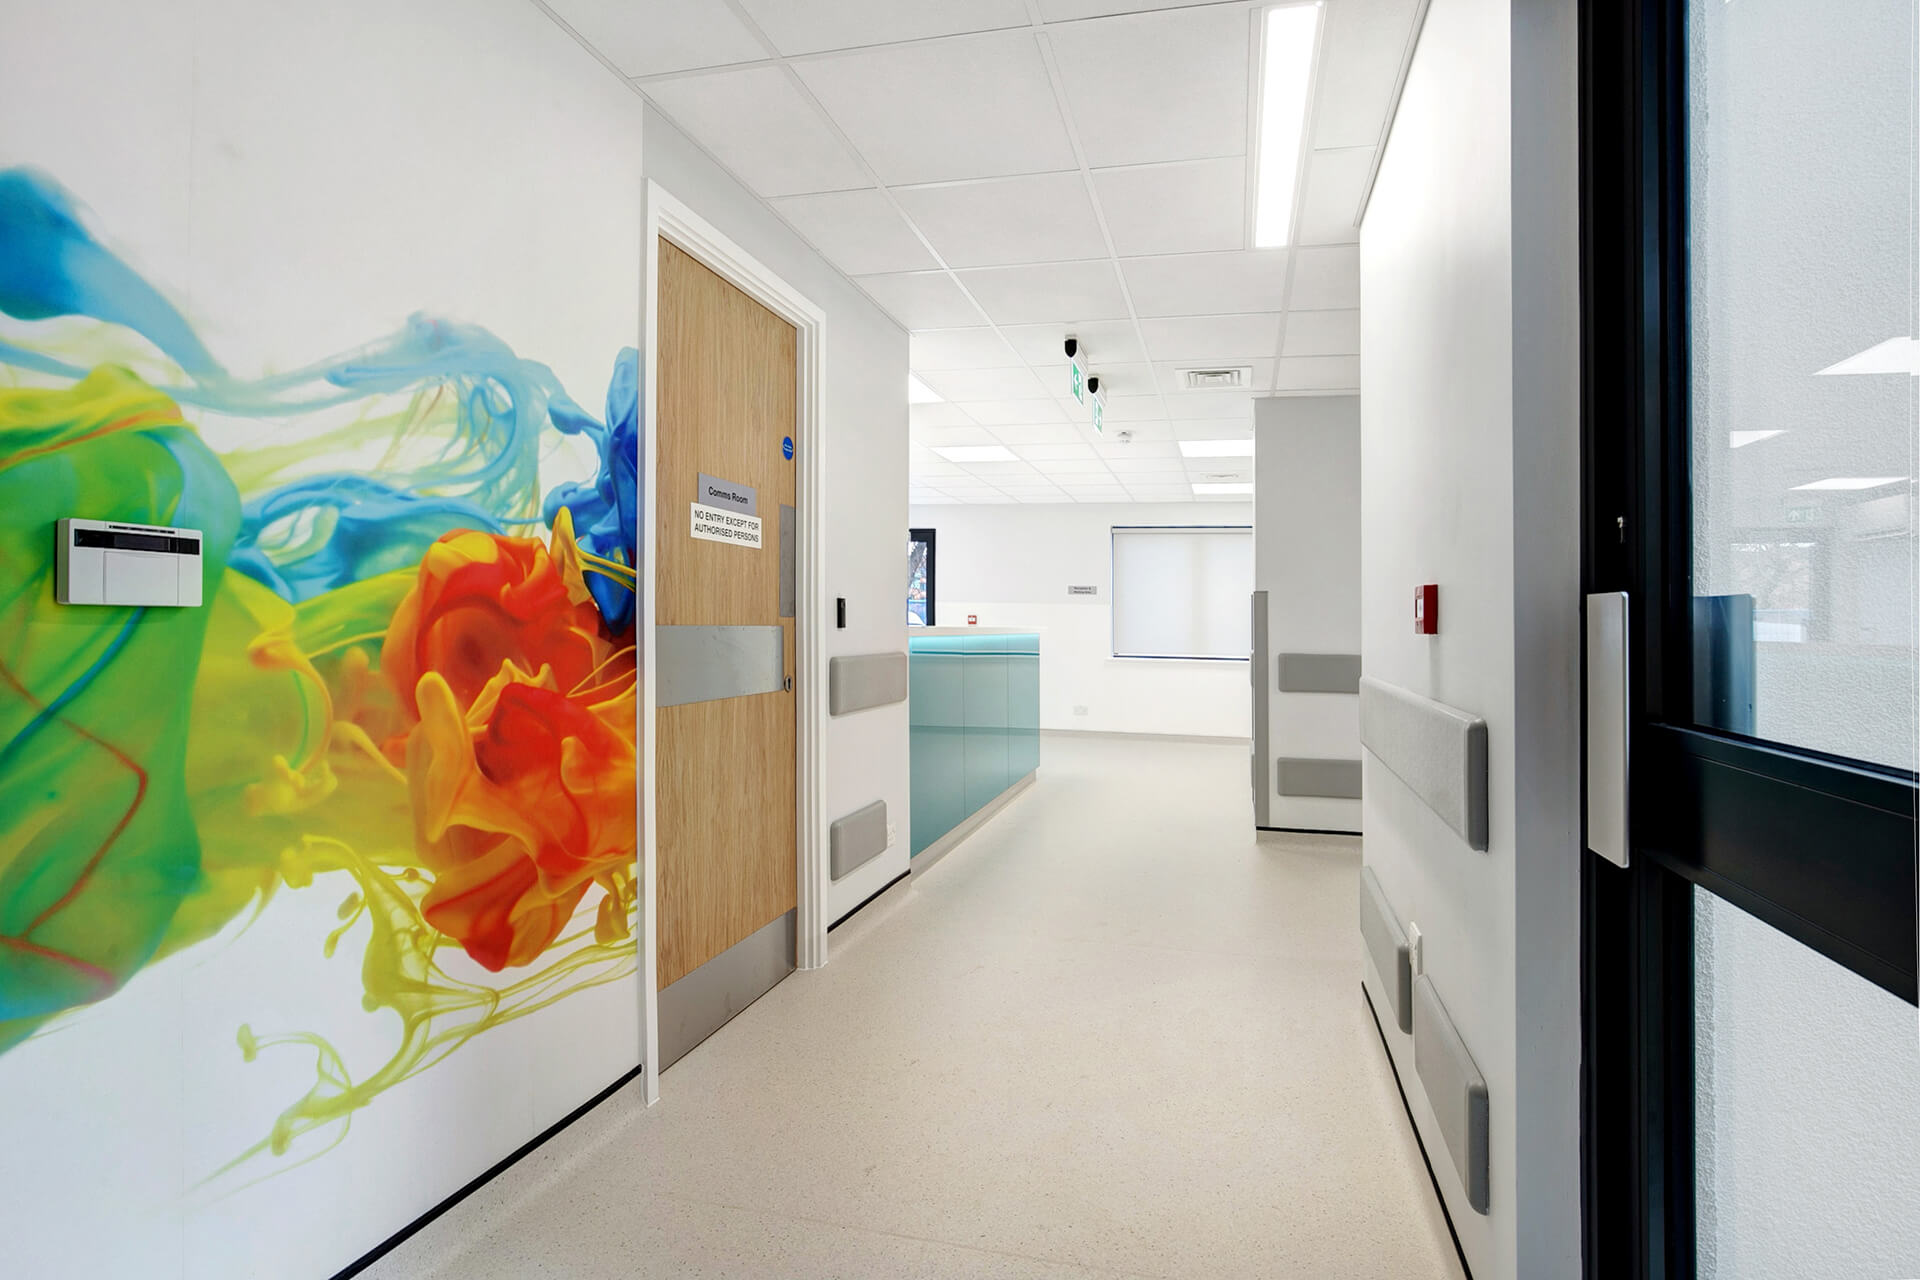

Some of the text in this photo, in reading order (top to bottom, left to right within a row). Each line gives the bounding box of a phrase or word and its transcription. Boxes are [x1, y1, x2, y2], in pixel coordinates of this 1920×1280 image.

[708, 486, 749, 504] Comms Room
[694, 510, 759, 531] NO ENTRY EXCEPT FOR
[694, 523, 759, 543] AUTHORISED PERSONS
